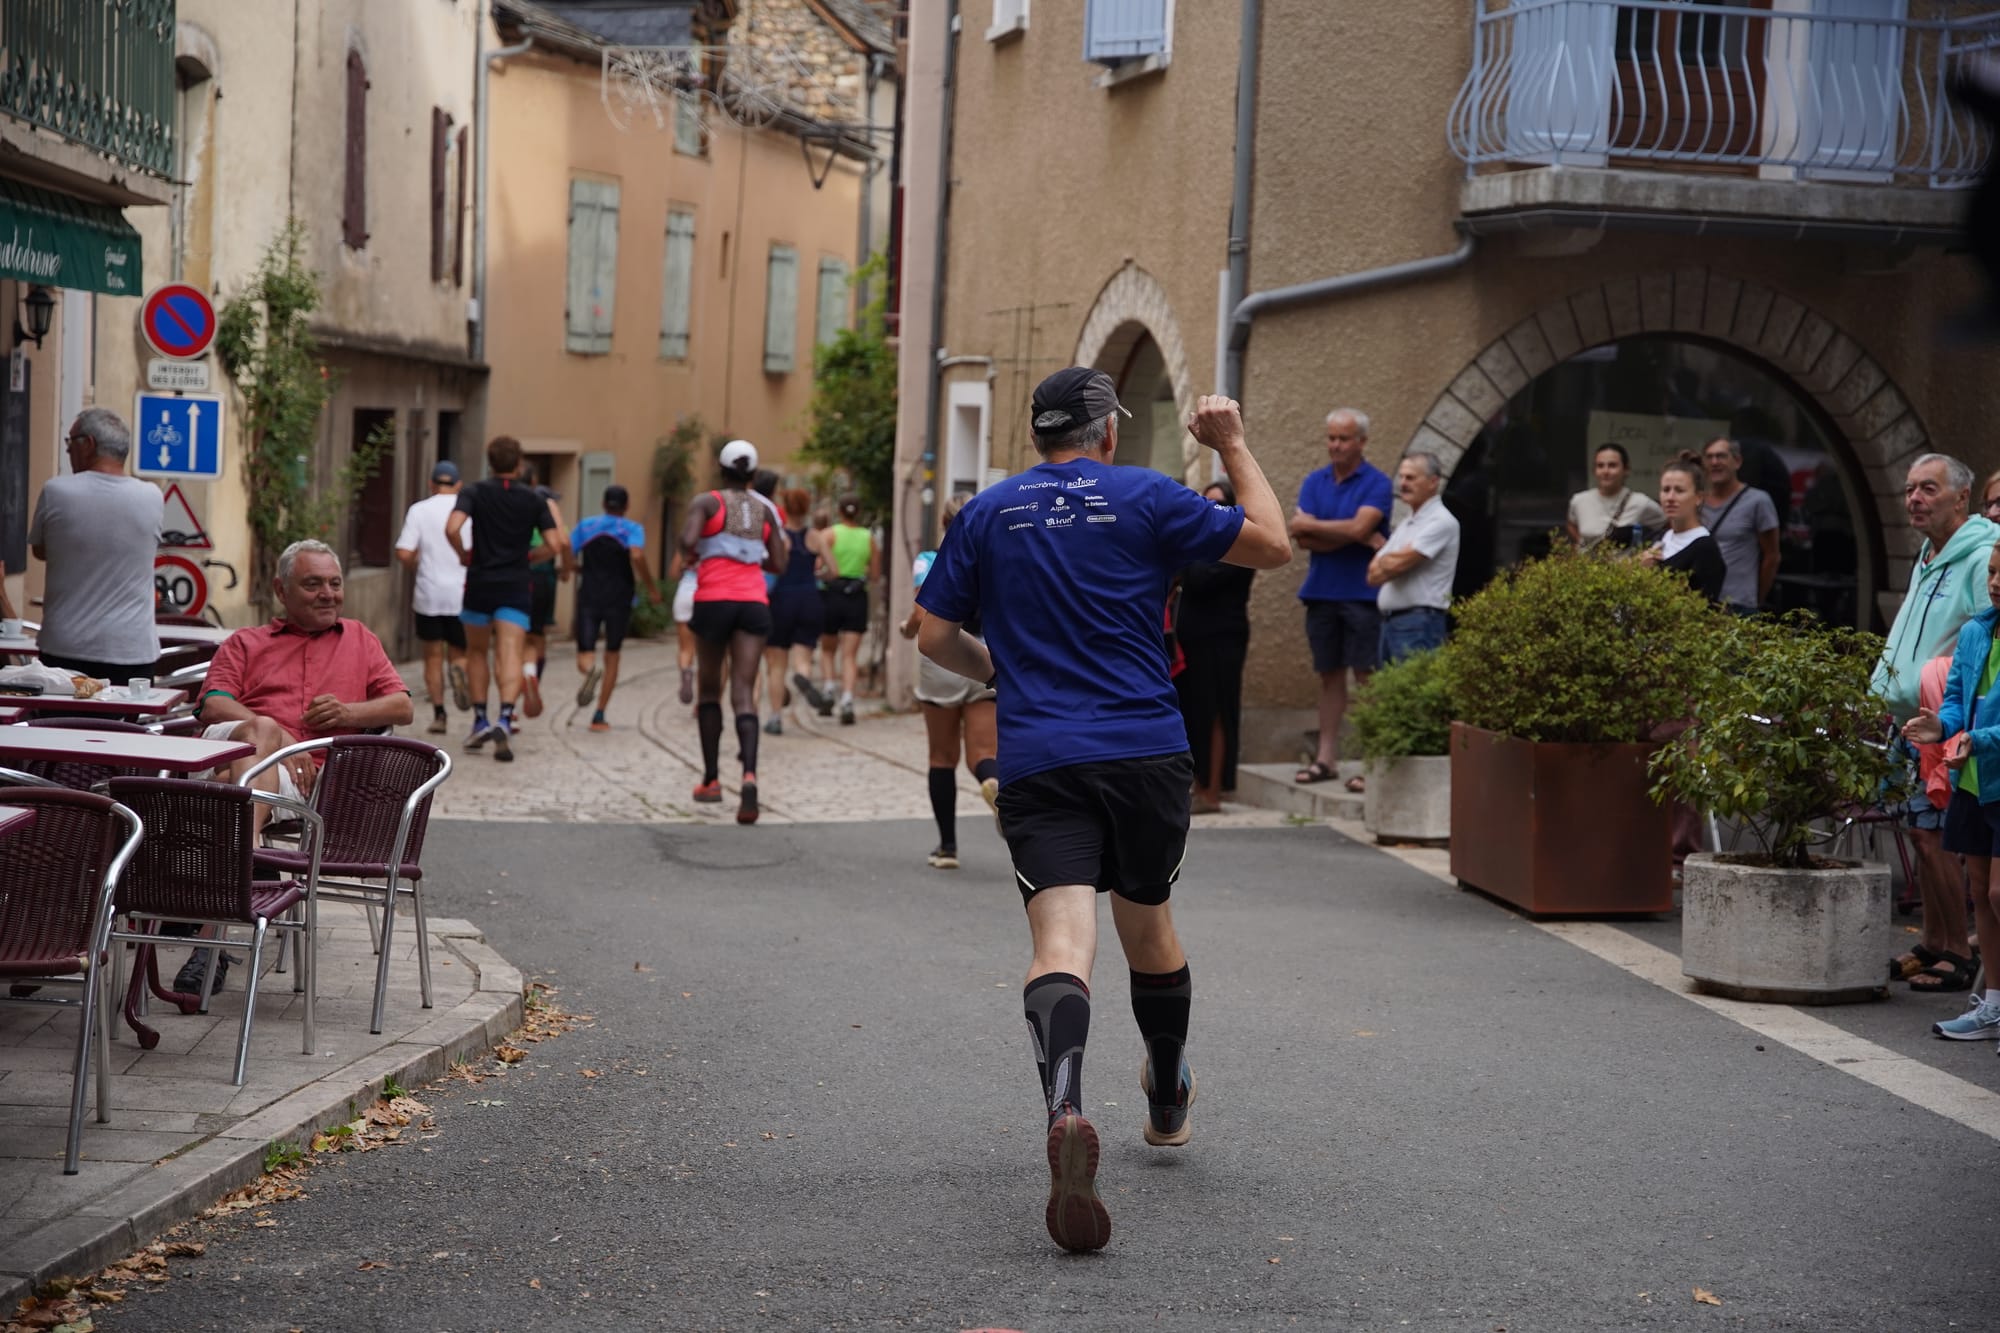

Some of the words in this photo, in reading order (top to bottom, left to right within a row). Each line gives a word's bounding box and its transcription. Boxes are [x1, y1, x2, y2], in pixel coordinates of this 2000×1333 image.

[0, 225, 61, 277] ulodrome
[158, 365, 200, 375] INTERDIT
[152, 374, 168, 384] DES
[1008, 522, 1034, 531] GARMIN
